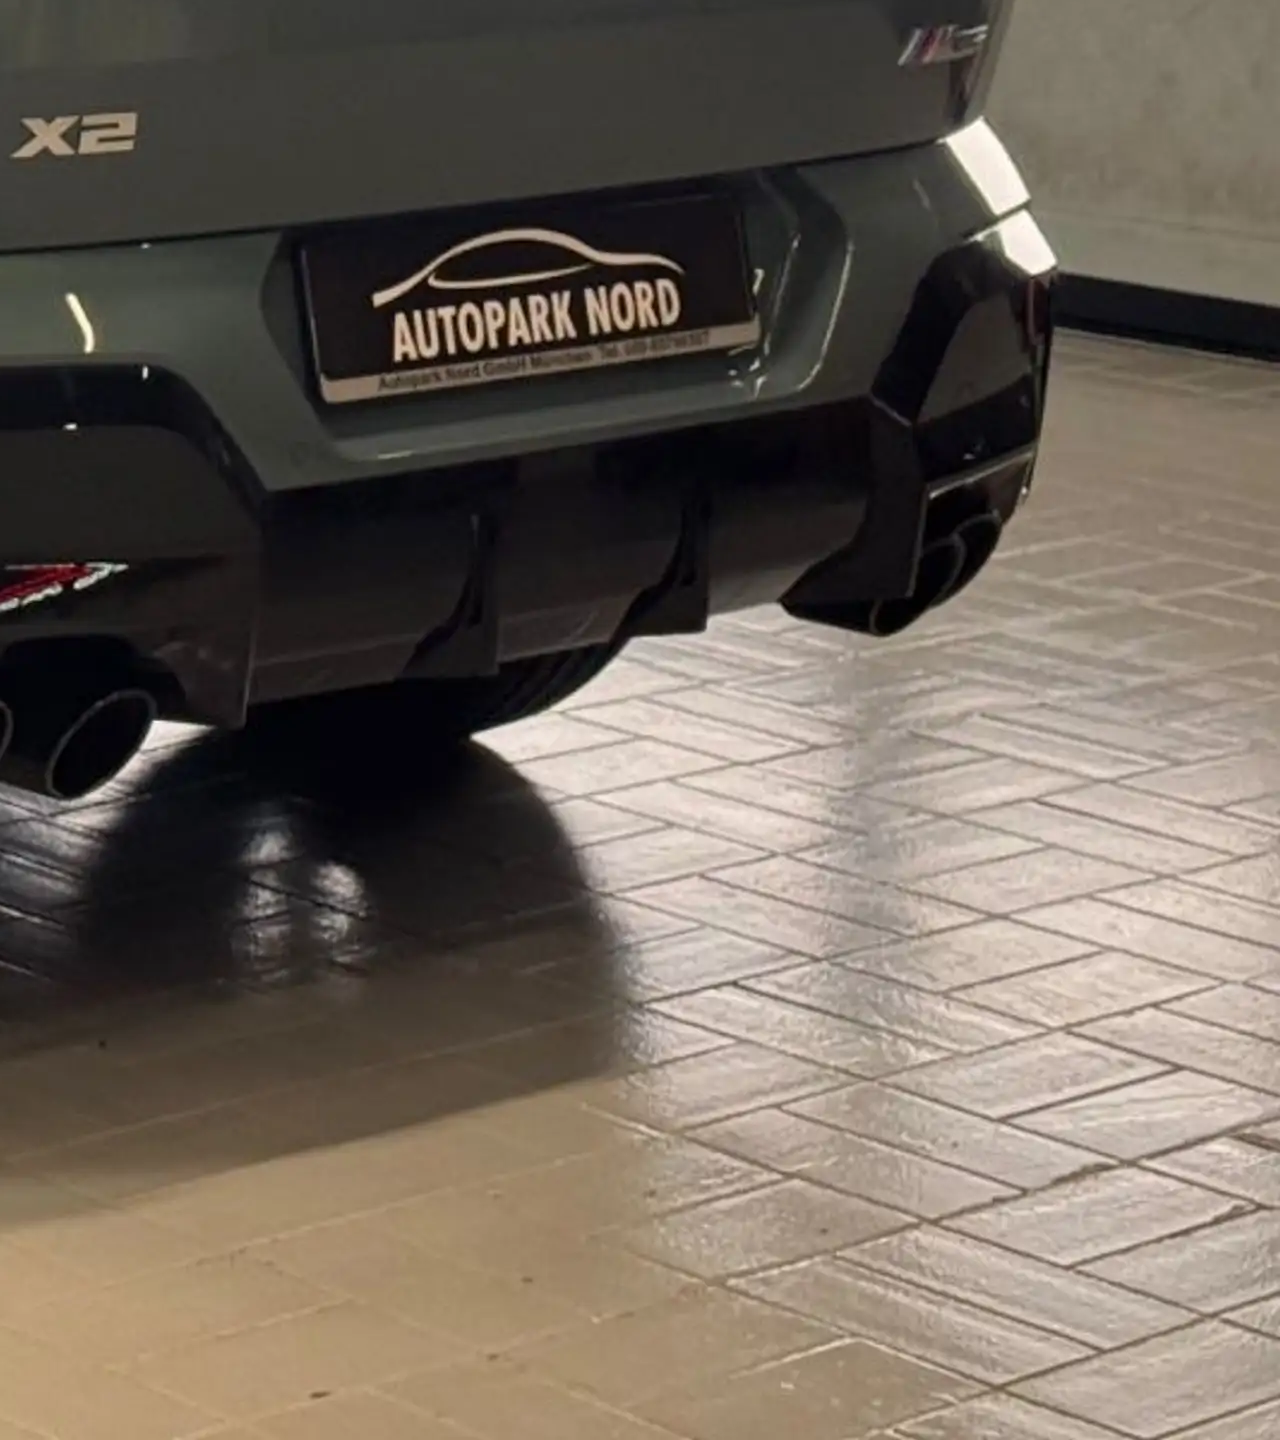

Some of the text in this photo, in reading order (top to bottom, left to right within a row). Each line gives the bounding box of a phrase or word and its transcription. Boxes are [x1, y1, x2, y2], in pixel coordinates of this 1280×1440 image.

[9, 112, 138, 158] X2
[393, 290, 578, 362] AUTOPARK
[583, 278, 681, 336] NORD
